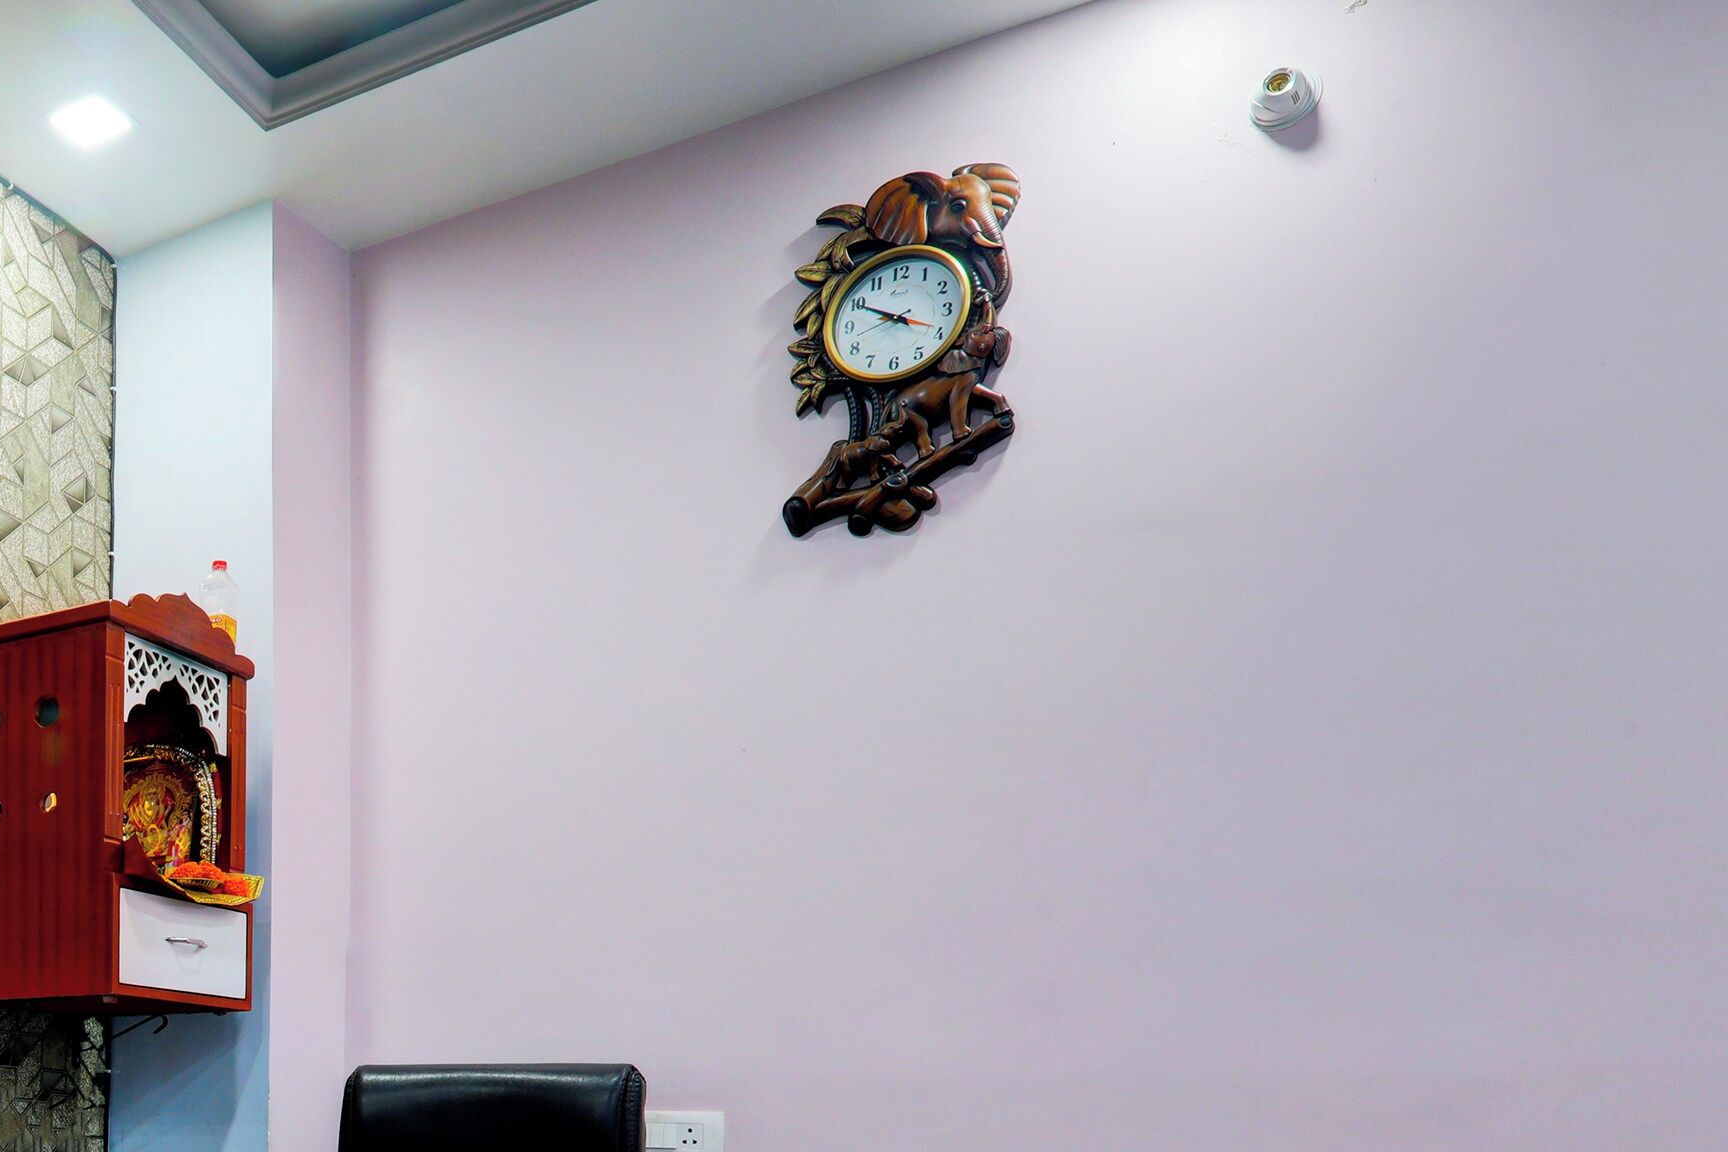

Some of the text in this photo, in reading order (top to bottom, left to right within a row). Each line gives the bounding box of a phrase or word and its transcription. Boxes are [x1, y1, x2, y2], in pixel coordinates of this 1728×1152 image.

[892, 265, 910, 282] 12
[922, 267, 928, 282] 1
[870, 275, 883, 292] 11
[936, 280, 948, 295] 2
[850, 296, 866, 312] 10
[941, 302, 953, 316] 3
[844, 320, 855, 335] 9
[933, 326, 944, 341] 4
[849, 341, 860, 356] 8
[913, 346, 925, 361] 5
[865, 354, 877, 368] 7
[888, 356, 899, 370] 6
